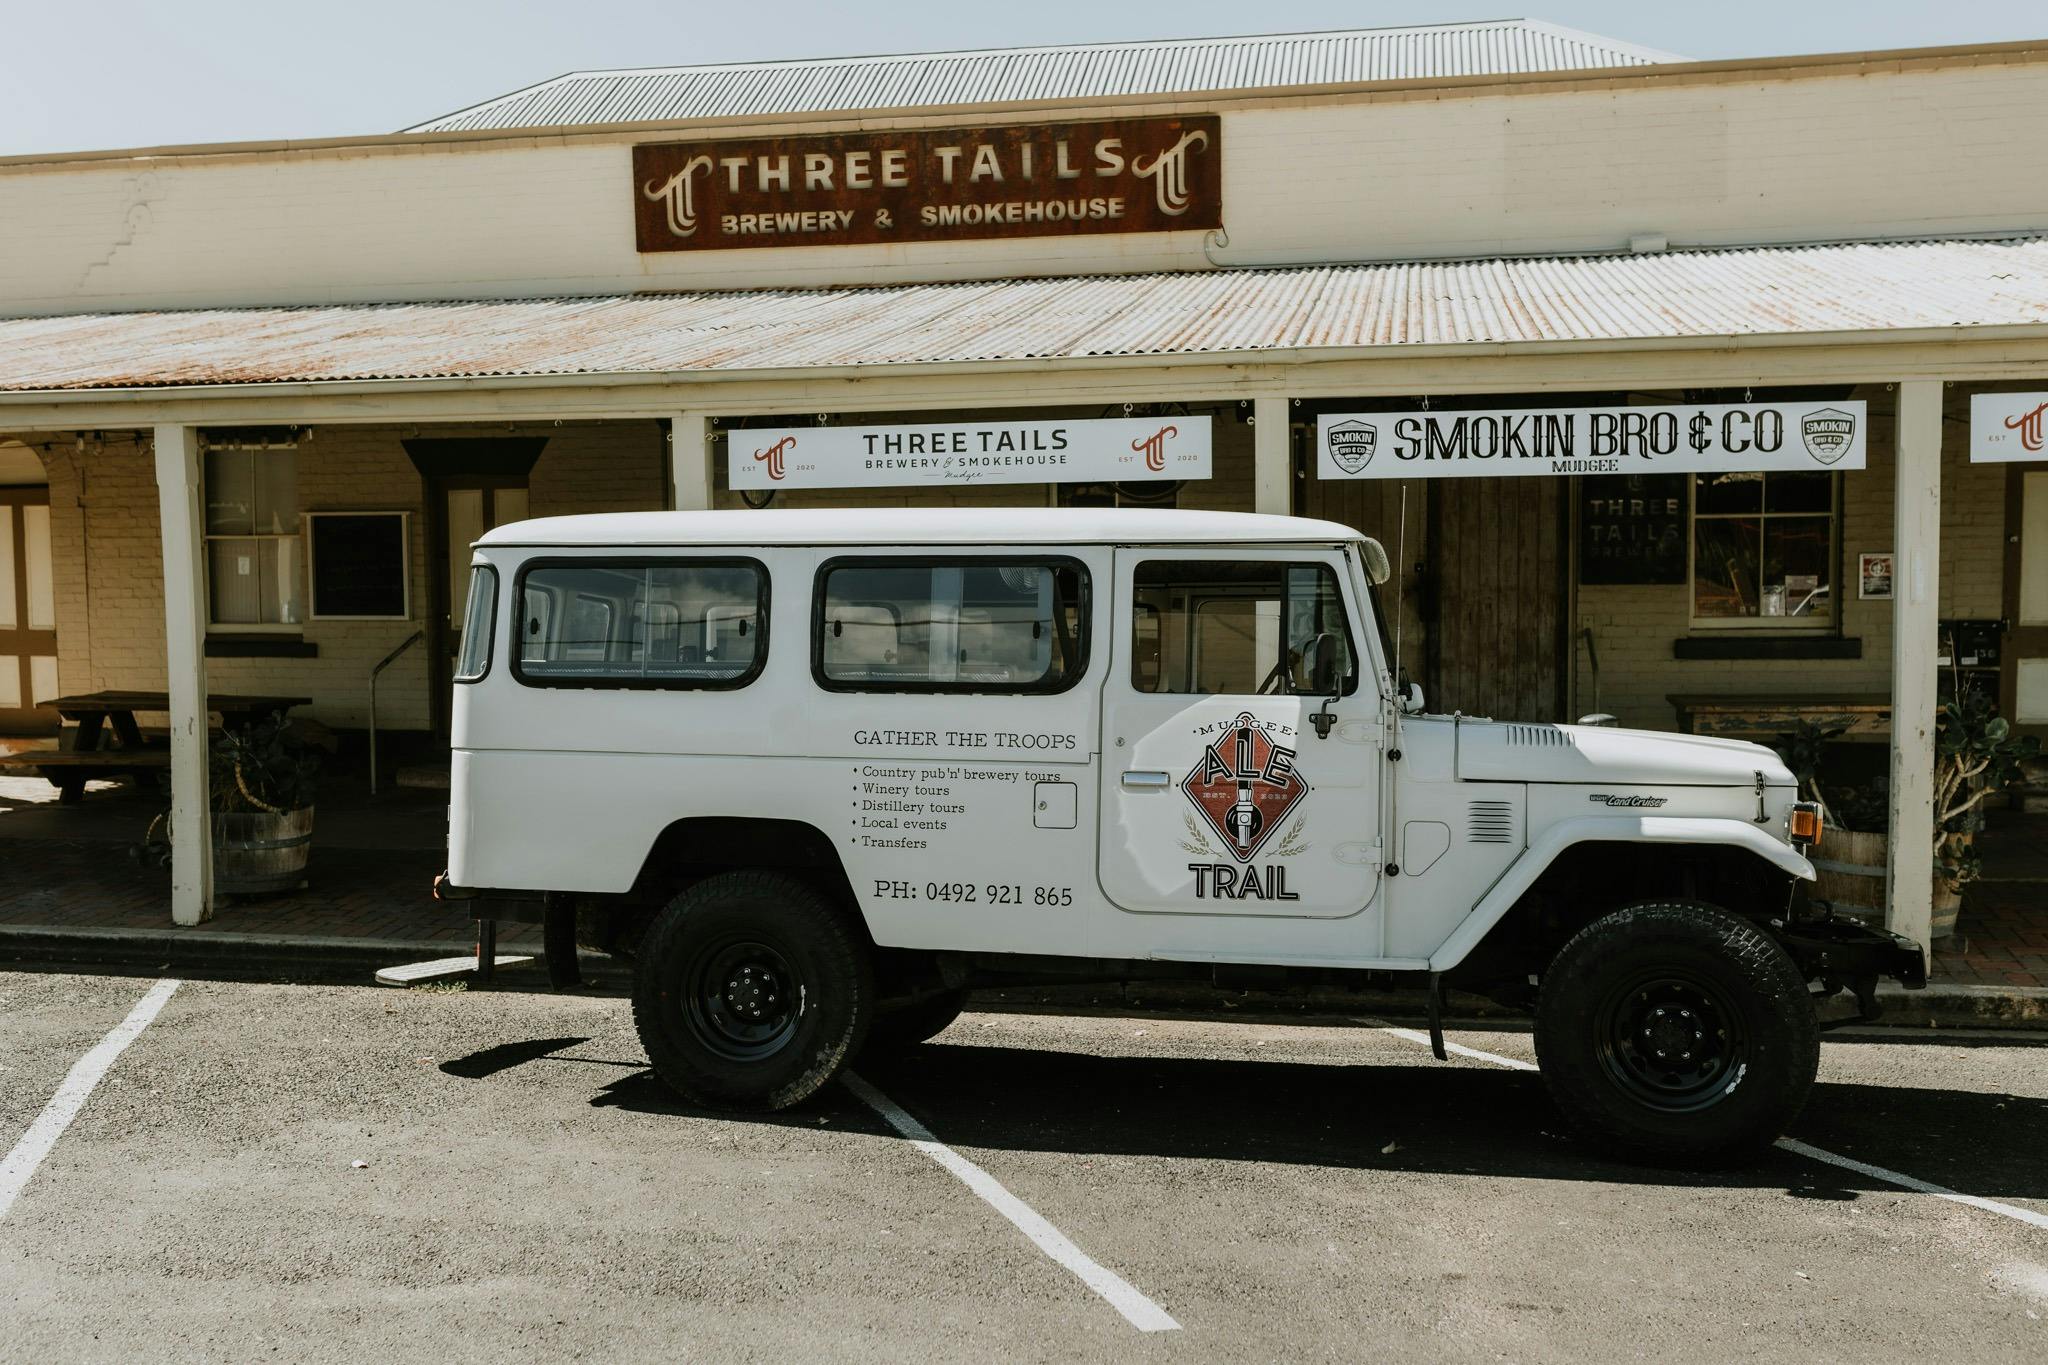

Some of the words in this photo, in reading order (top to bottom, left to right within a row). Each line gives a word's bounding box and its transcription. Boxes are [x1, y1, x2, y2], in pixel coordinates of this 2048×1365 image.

[720, 150, 909, 194] THREE
[935, 138, 1125, 184] TAILS
[721, 210, 855, 235] BREWERY
[875, 208, 894, 229] &
[920, 197, 1126, 226] SMOKEHOUSE
[1394, 414, 1575, 461] SMOKIN
[1589, 411, 1678, 461] BRO
[1722, 409, 1784, 453] CO
[1806, 420, 1850, 433] SMOKIN
[863, 432, 967, 454] THREE
[977, 429, 1067, 451] TAILS
[1331, 432, 1372, 444] SMOKIN
[865, 459, 938, 468] BREWERY
[943, 457, 953, 468] &
[959, 455, 1067, 467] SMOKEHOUSE
[1552, 459, 1618, 472] MUDGEE
[1590, 498, 1679, 515] THREE
[1590, 524, 1678, 542] TAILS
[1199, 719, 1293, 736] MUDGEE
[854, 730, 938, 747] GATHER
[945, 732, 988, 747] THE
[994, 733, 1076, 749] TROOPS
[1203, 739, 1297, 788] ALE
[862, 766, 916, 781] Country
[964, 769, 1019, 783] brewery
[1025, 771, 1060, 782] tours
[862, 783, 909, 797] Winery
[915, 785, 950, 796] tours
[862, 800, 924, 815] Distillery
[930, 802, 965, 813] tours
[1607, 795, 1631, 806] Land
[1631, 796, 1668, 807] Cruiser
[861, 817, 898, 828] Local
[903, 820, 947, 830] events
[862, 836, 927, 849] Transfers
[1188, 863, 1300, 900] TRAIL
[874, 880, 917, 899] PH:
[926, 883, 976, 902] 0492
[986, 885, 1022, 904] 921
[1034, 887, 1072, 906] 865
